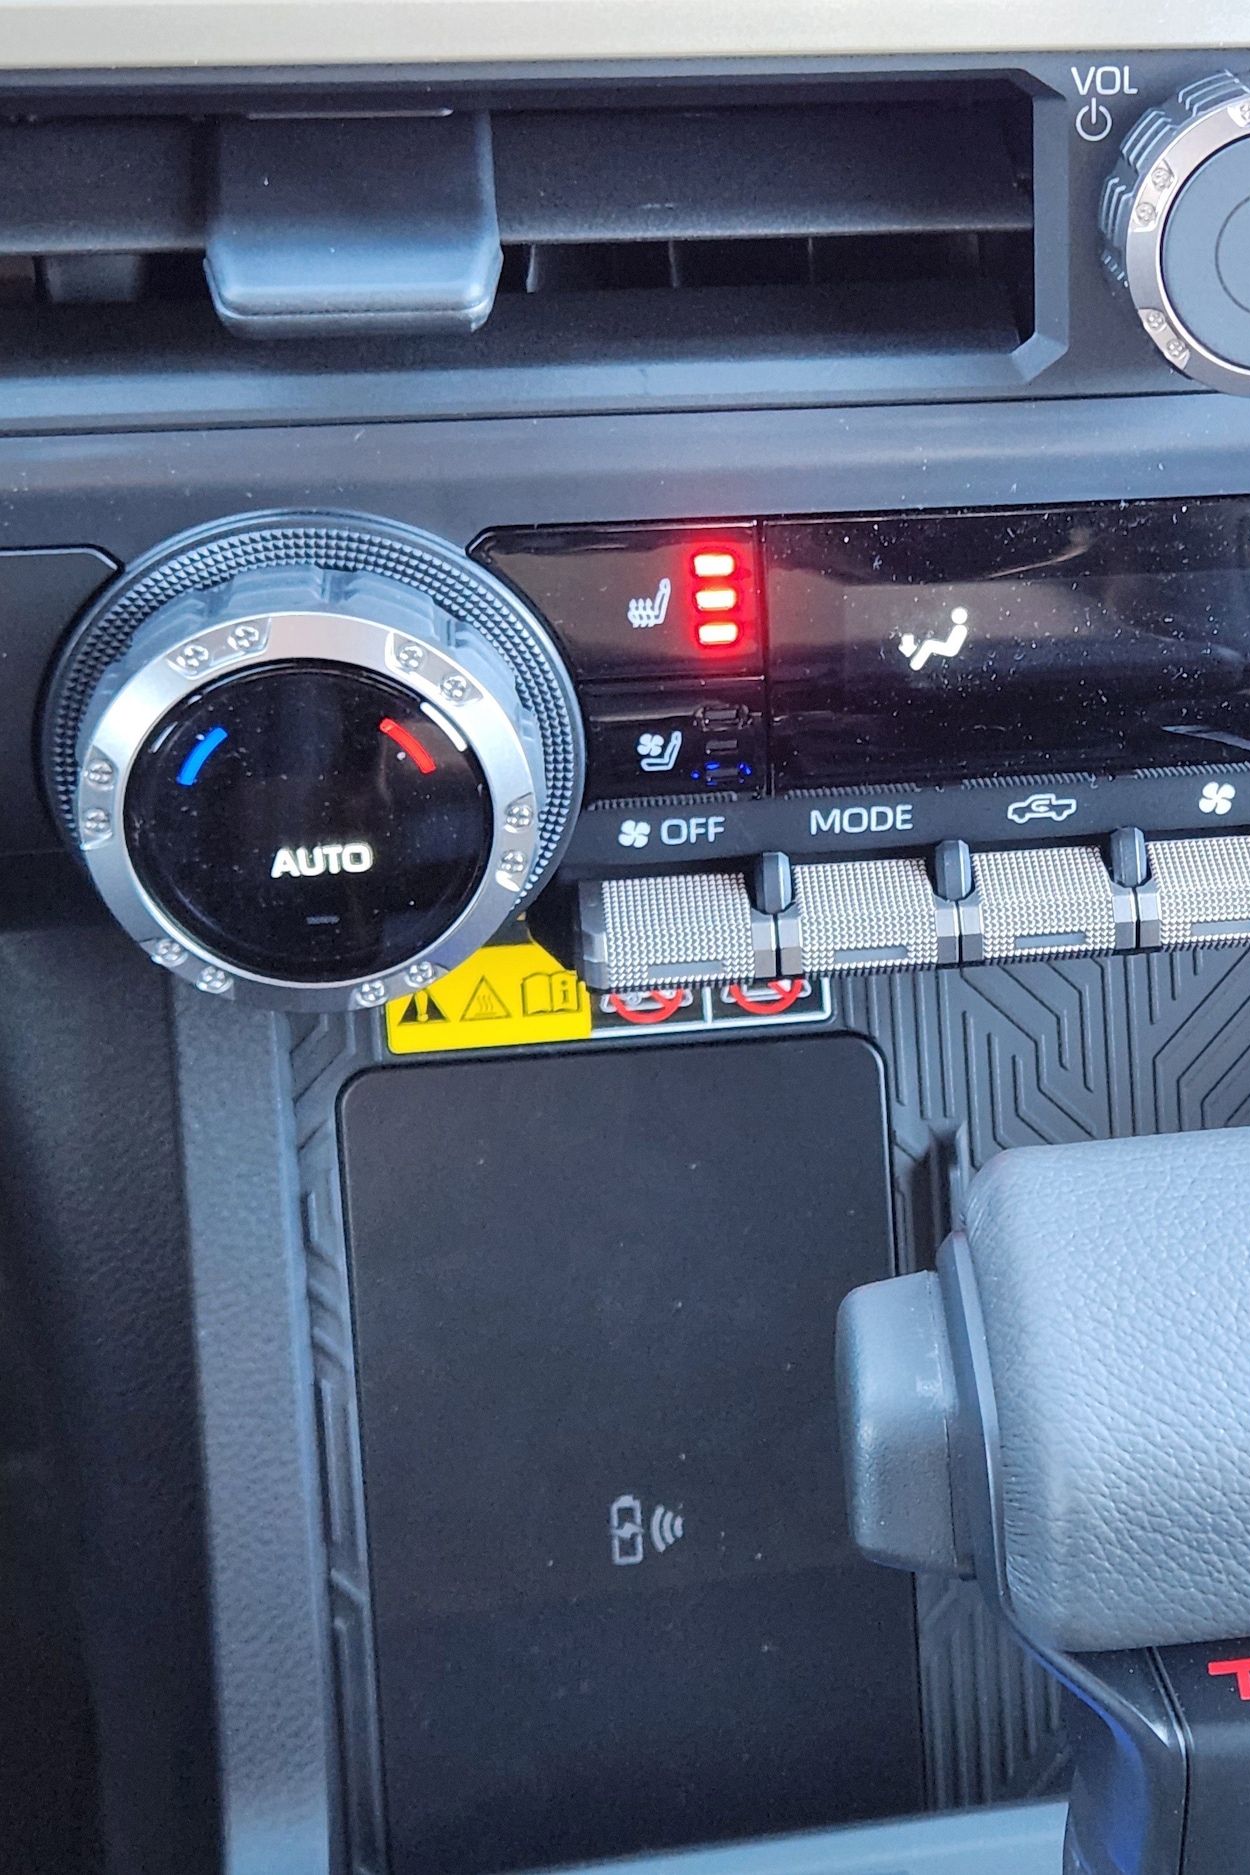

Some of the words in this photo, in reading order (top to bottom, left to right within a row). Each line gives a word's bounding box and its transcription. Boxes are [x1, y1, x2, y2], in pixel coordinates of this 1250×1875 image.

[1071, 66, 1138, 95] VOL
[660, 817, 726, 846] OFF
[810, 804, 914, 835] MODE
[271, 842, 374, 878] AUTO
